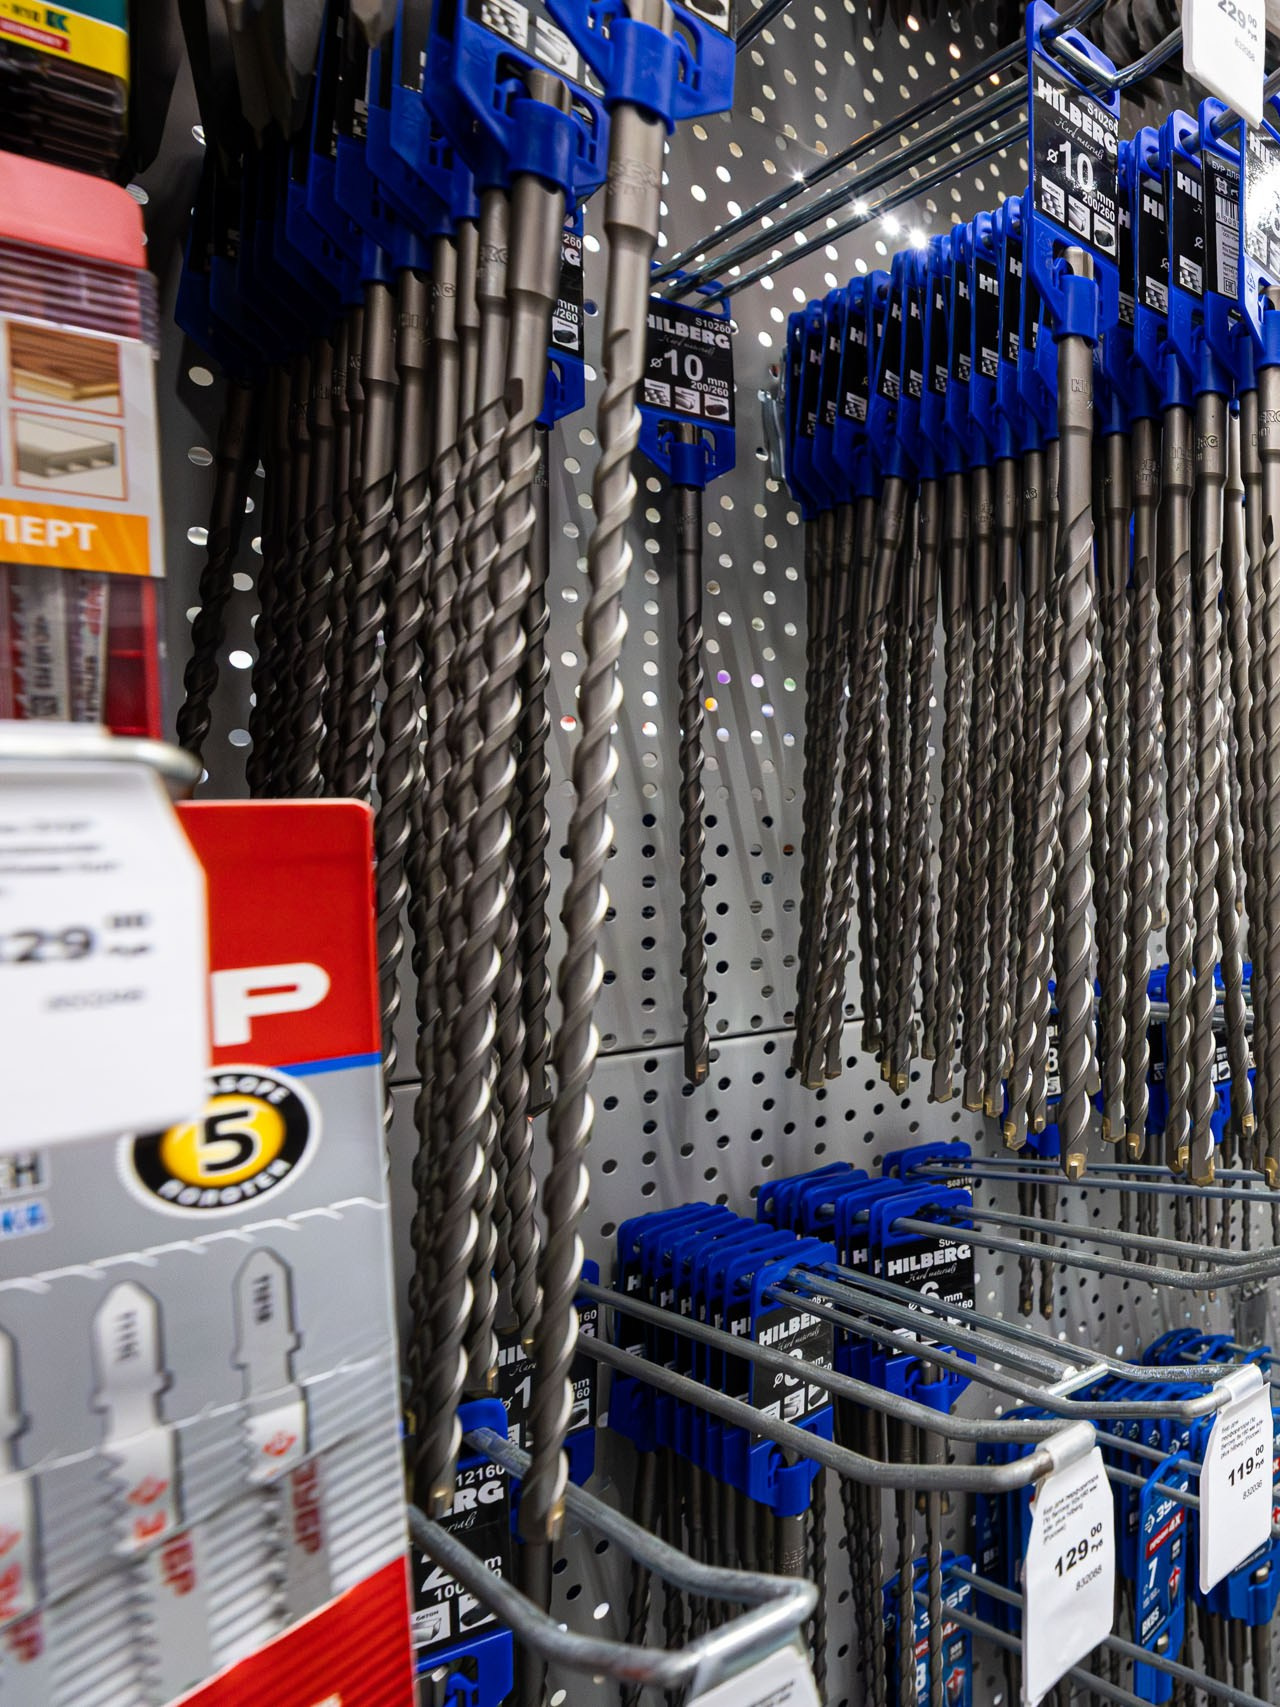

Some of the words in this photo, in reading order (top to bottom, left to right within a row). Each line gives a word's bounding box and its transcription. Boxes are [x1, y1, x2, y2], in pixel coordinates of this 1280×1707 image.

[1037, 75, 1118, 156] HILBERG
[1082, 191, 1115, 222] 200/260
[1096, 190, 1115, 211] mm
[563, 233, 582, 249] 260
[554, 308, 579, 322] /260
[695, 317, 732, 334] S10260
[646, 313, 731, 350] HILBERG
[690, 380, 729, 398] 200/260
[707, 377, 728, 389] mm
[204, 1075, 290, 1104] БОРЕ
[203, 1108, 257, 1174] 5
[887, 1244, 971, 1277] HILBERG
[943, 1291, 963, 1302] mm
[759, 1313, 821, 1346] HILBE
[454, 1463, 506, 1487] 12160
[1228, 1456, 1254, 1487] 119
[1255, 1444, 1264, 1457] 00
[1156, 1481, 1189, 1523] ЗУР
[1055, 1539, 1088, 1577] 129
[1090, 1522, 1102, 1537] 00
[919, 1584, 971, 1630] ЗБР
